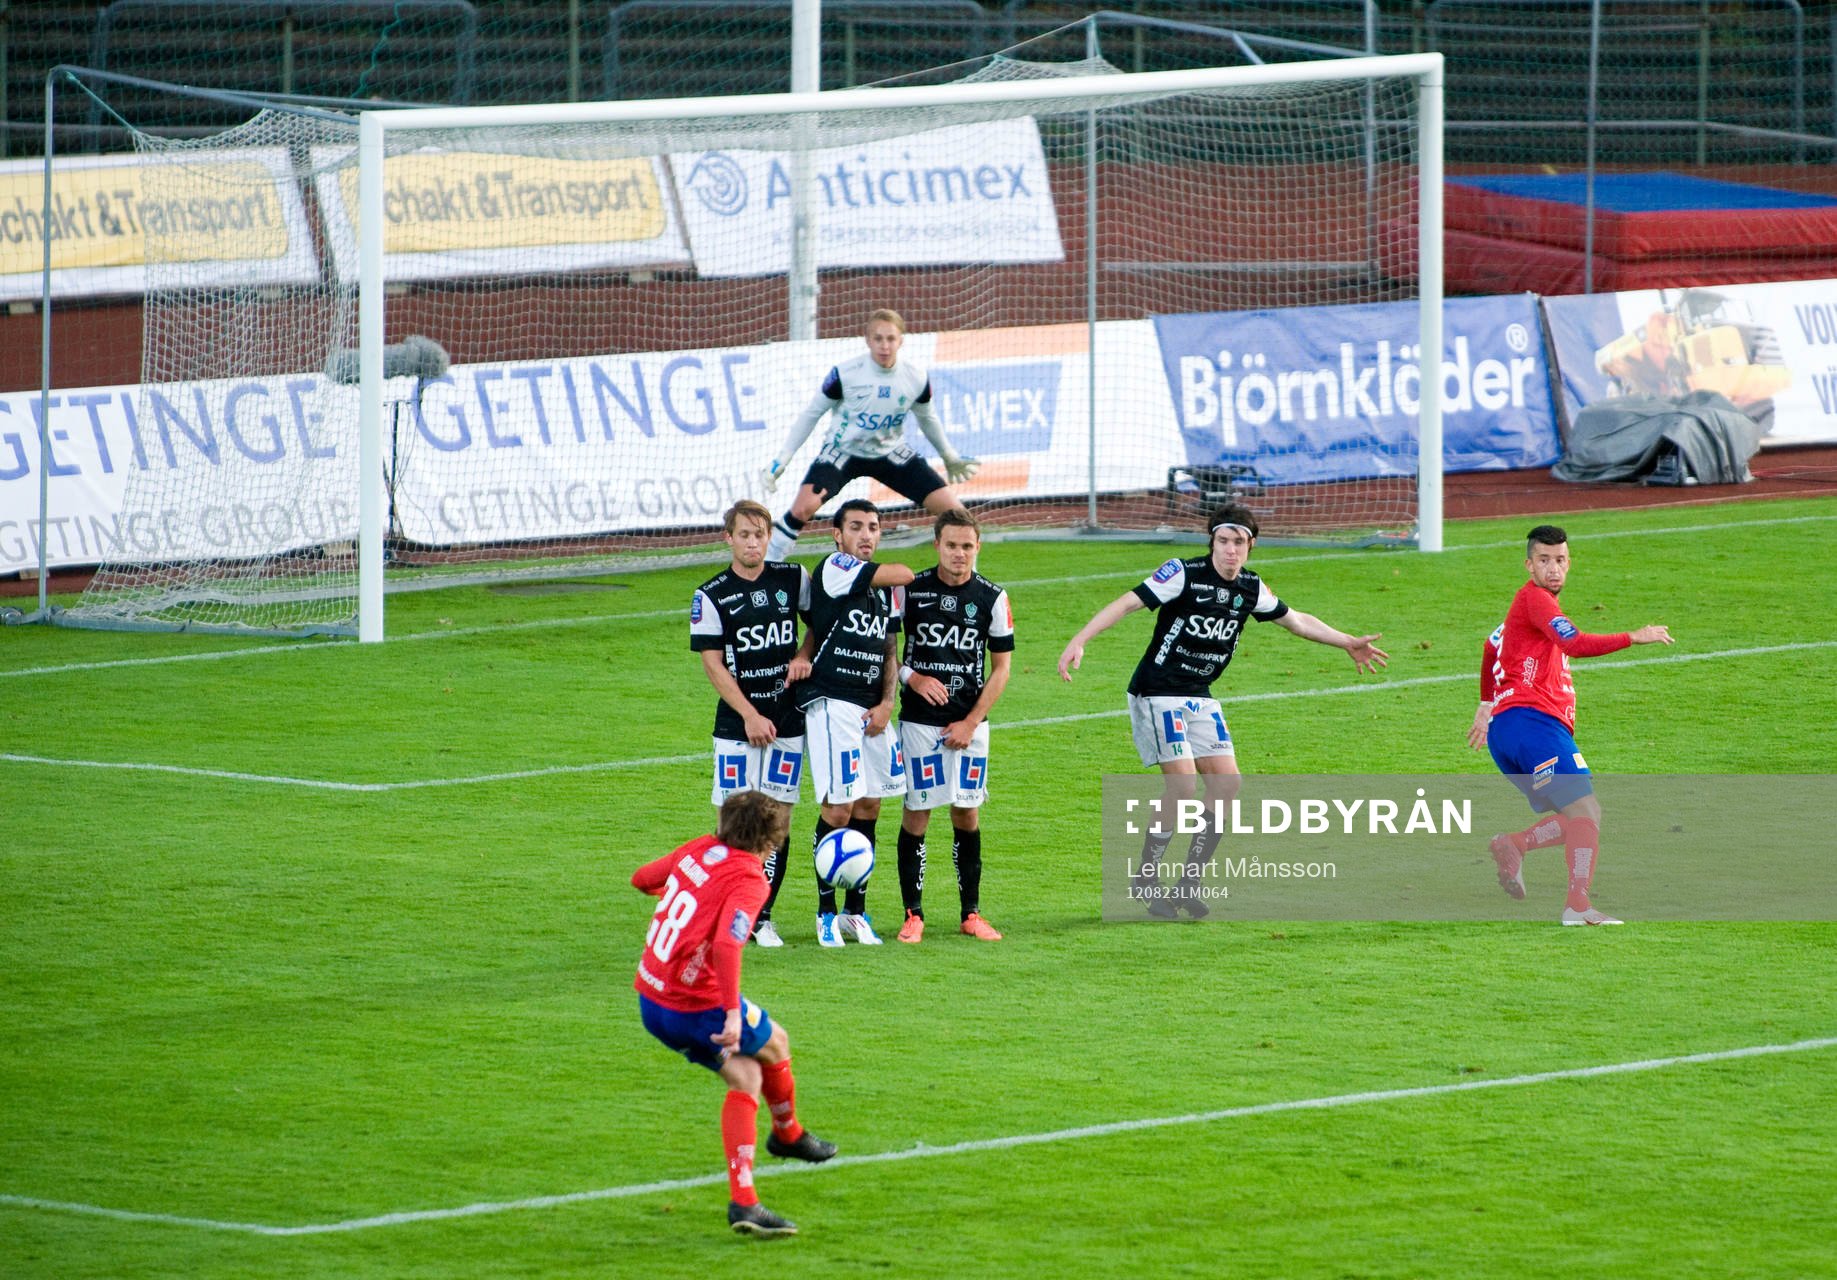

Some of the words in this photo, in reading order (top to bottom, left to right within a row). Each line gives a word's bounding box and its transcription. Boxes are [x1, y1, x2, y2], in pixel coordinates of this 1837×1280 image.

[0, 187, 272, 244] chakt&Transport
[384, 169, 649, 223] chakt&Transport
[410, 353, 767, 452] GETINGE
[856, 412, 906, 431] SSAB
[917, 388, 1049, 436] LWEX
[0, 379, 336, 481] GETINGE
[437, 480, 621, 533] GETINGE
[0, 510, 187, 562] GETINGE
[736, 620, 793, 652] SSAB
[916, 622, 979, 650] SSAB
[1185, 615, 1239, 640] SSAB
[914, 660, 965, 673] DALATRAFIK
[1172, 743, 1183, 756] 14
[920, 791, 928, 803] 9
